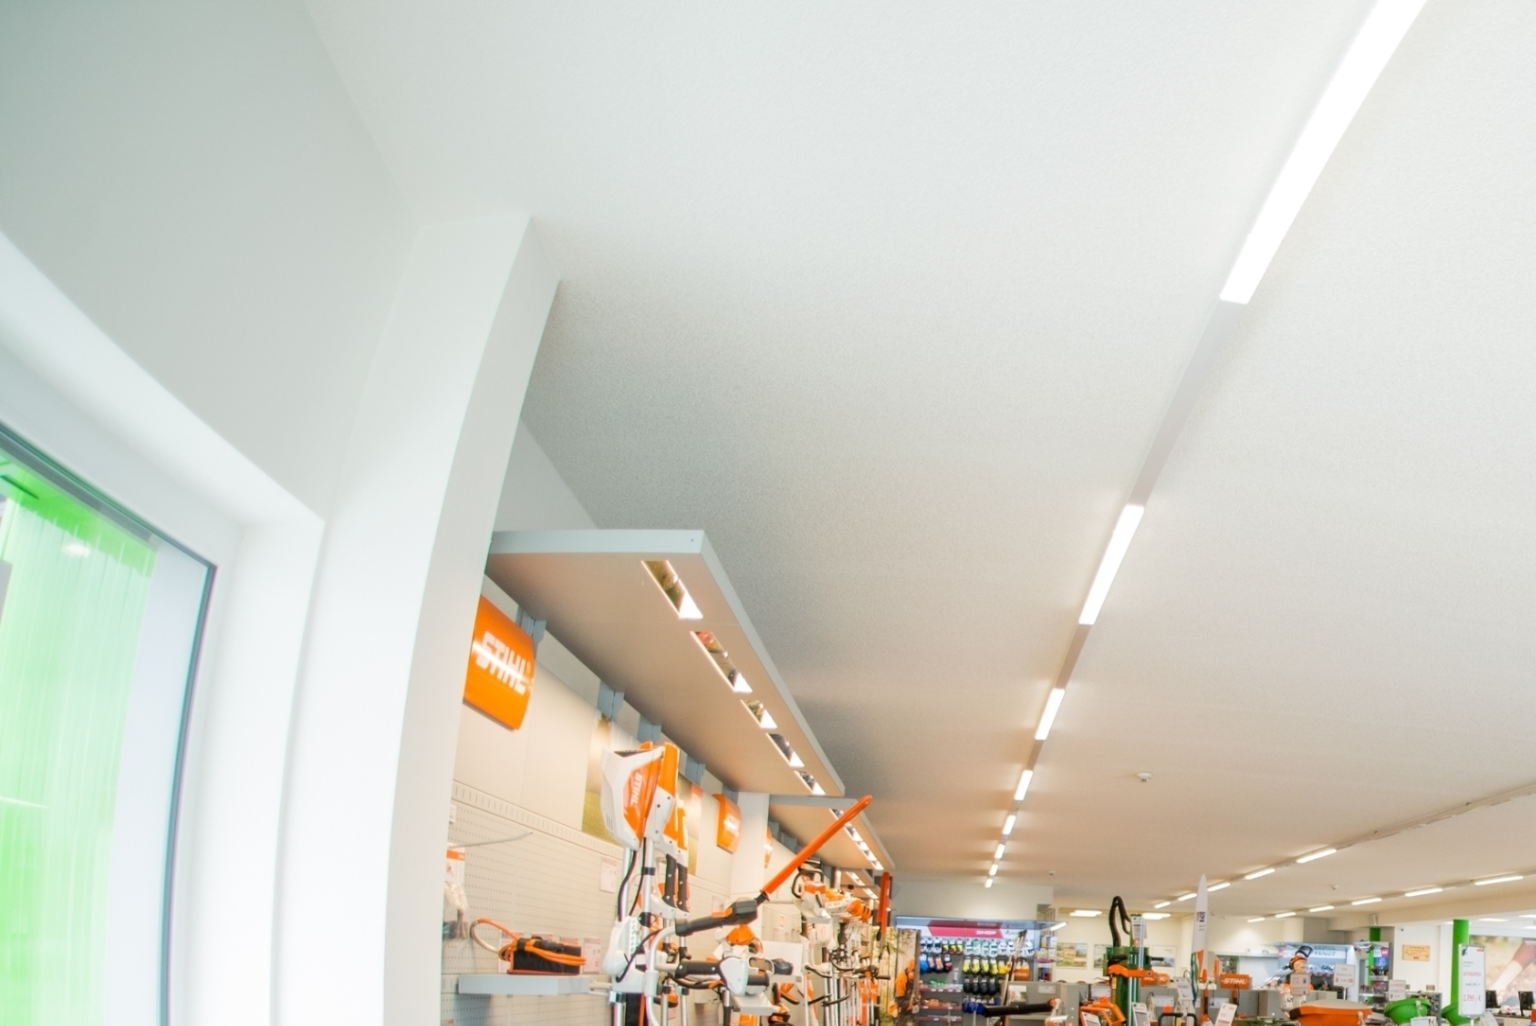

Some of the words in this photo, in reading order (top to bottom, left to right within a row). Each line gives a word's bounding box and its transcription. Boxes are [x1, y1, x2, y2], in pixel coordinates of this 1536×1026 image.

[475, 630, 531, 696] STIHL
[629, 772, 643, 806] STIHL
[1222, 977, 1248, 985] STIHL
